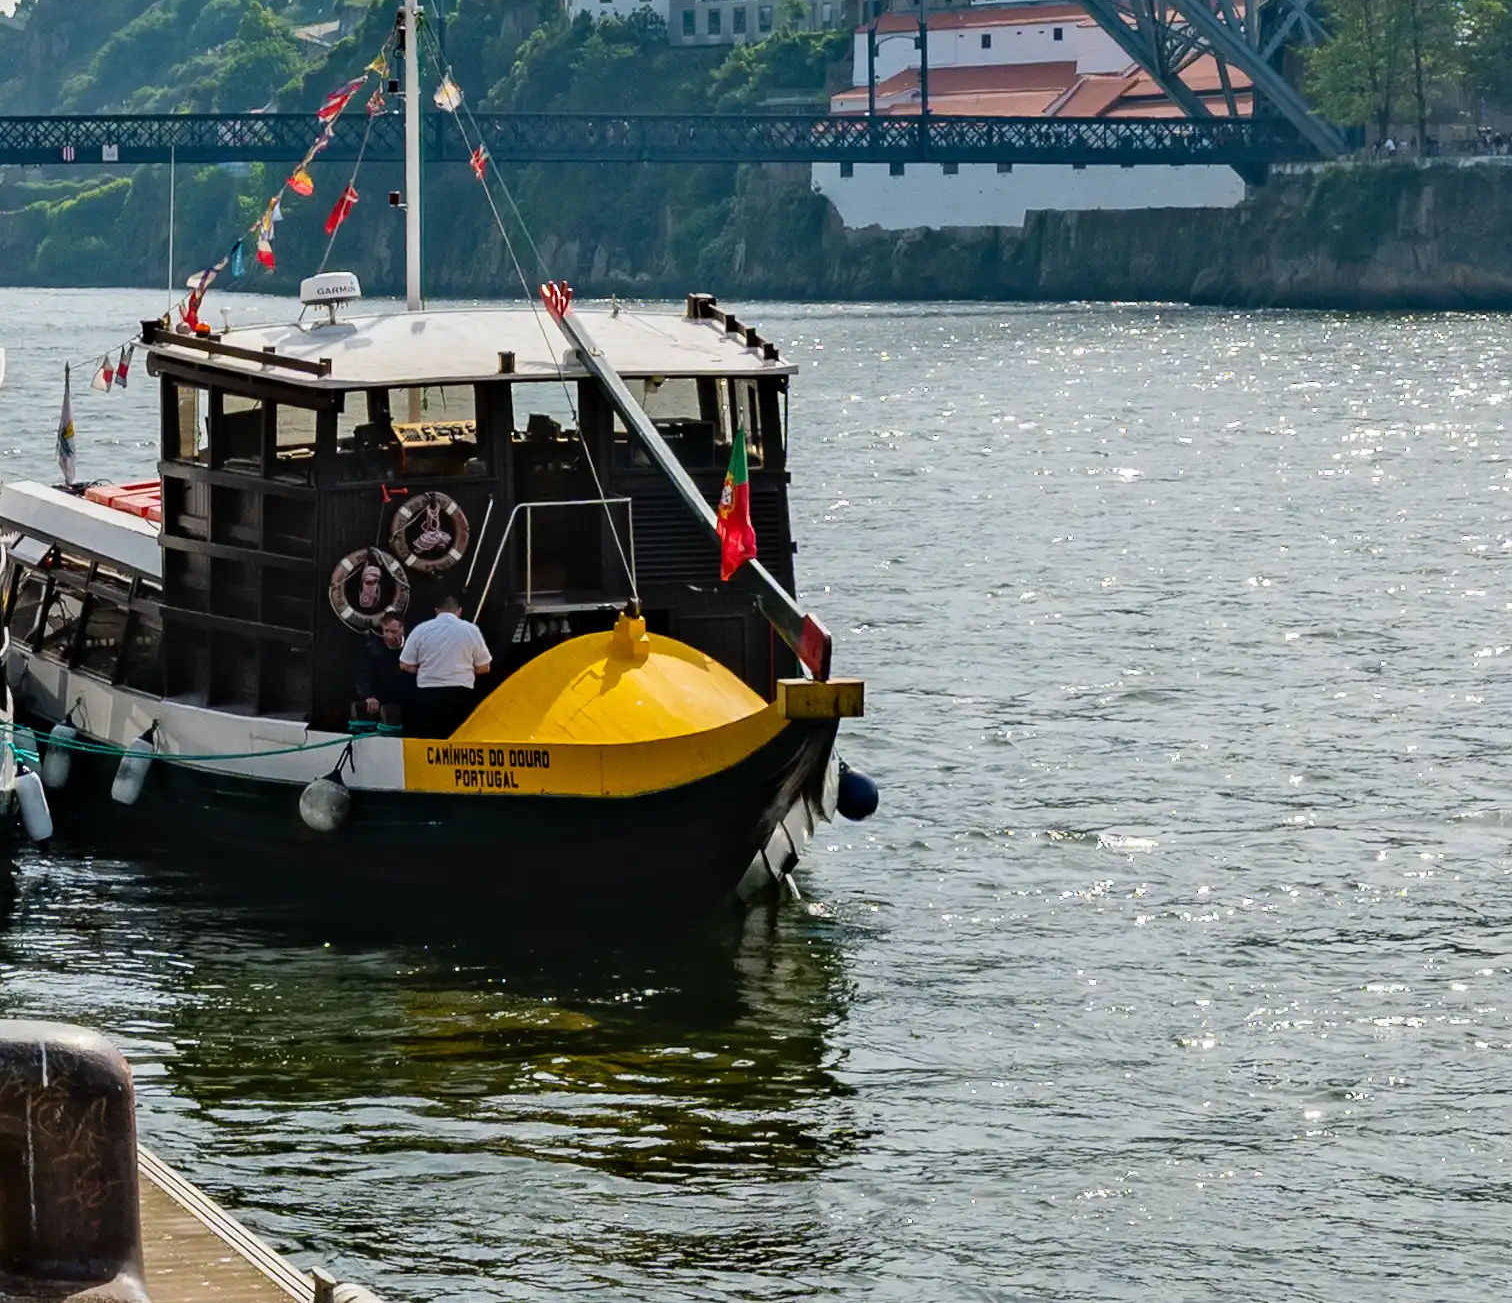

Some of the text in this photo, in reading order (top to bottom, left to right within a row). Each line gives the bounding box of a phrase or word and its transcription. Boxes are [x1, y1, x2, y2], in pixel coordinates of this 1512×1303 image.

[489, 748, 504, 767] DO
[509, 749, 550, 769] DOURO
[455, 769, 519, 788] PORTUGAL
